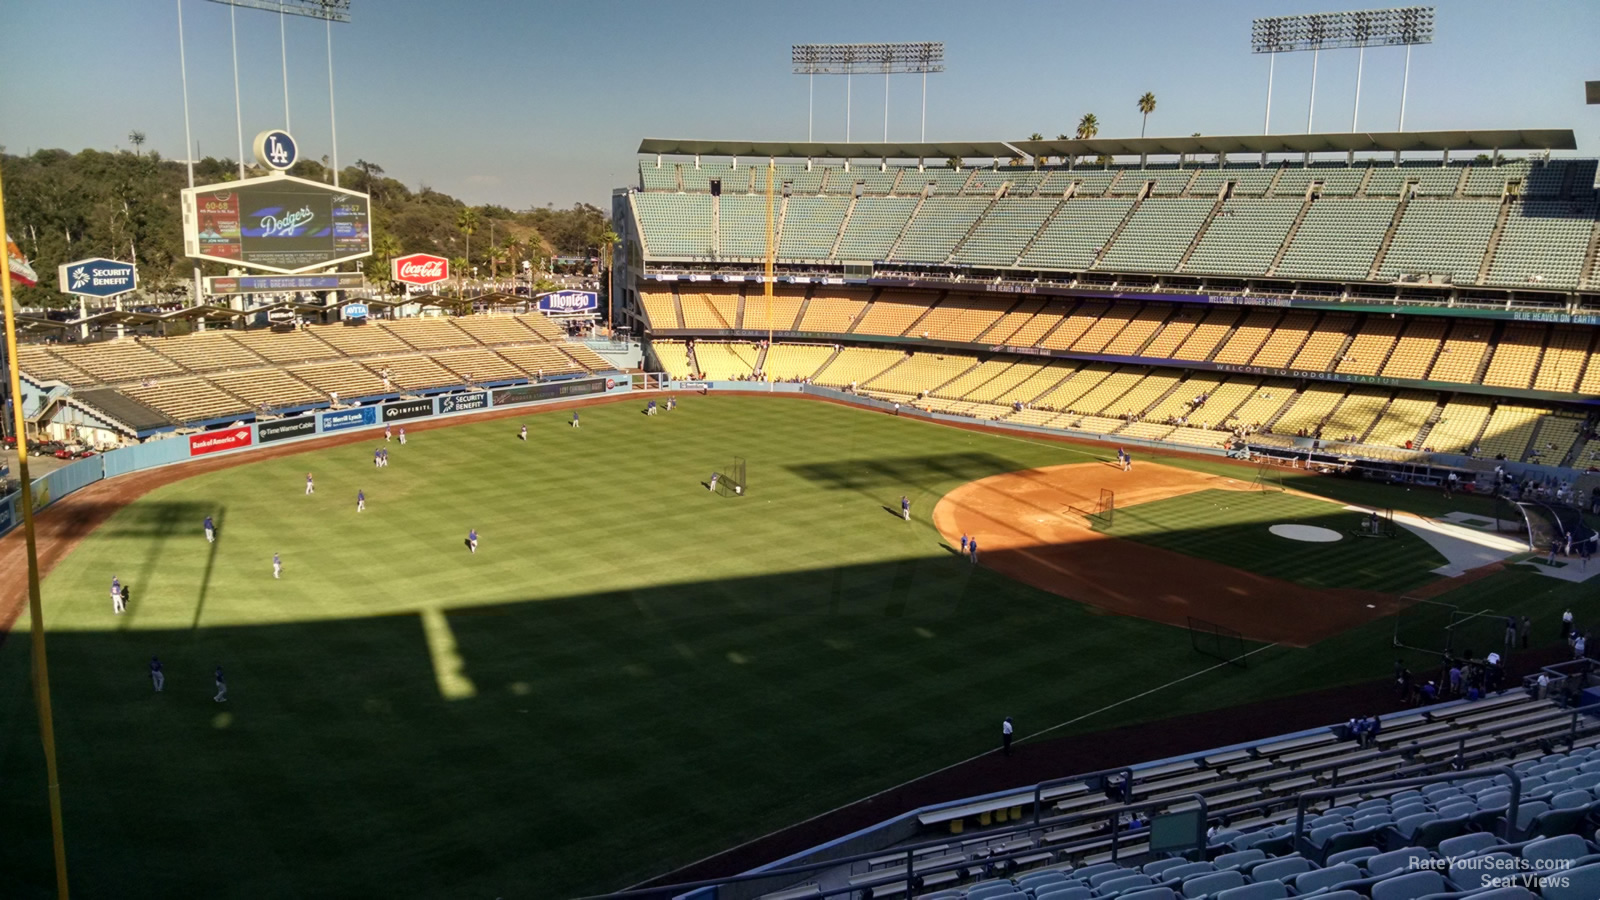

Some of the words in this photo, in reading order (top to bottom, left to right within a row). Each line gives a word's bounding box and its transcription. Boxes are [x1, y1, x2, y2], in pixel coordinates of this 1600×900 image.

[269, 136, 288, 163] LA
[260, 204, 314, 237] Dodgers
[92, 268, 131, 276] SECURITY
[400, 261, 444, 278] Coca-Cola
[93, 278, 127, 286] BENEFIT
[549, 293, 589, 309] Montejo
[1209, 296, 1234, 304] WELCOME
[1267, 298, 1291, 306] STADIUM
[1514, 312, 1530, 320] BLUE
[1532, 312, 1558, 322] HEAVEN
[1560, 314, 1570, 322] ON
[1573, 315, 1596, 324] EARTH
[1216, 364, 1268, 374] WELCOME
[1293, 371, 1340, 380] DODGER
[1346, 375, 1400, 385] STADIUM
[456, 394, 485, 403] SECURITY
[400, 405, 430, 413] INFINITI
[456, 401, 482, 410] BENEFIT
[213, 436, 236, 445] America
